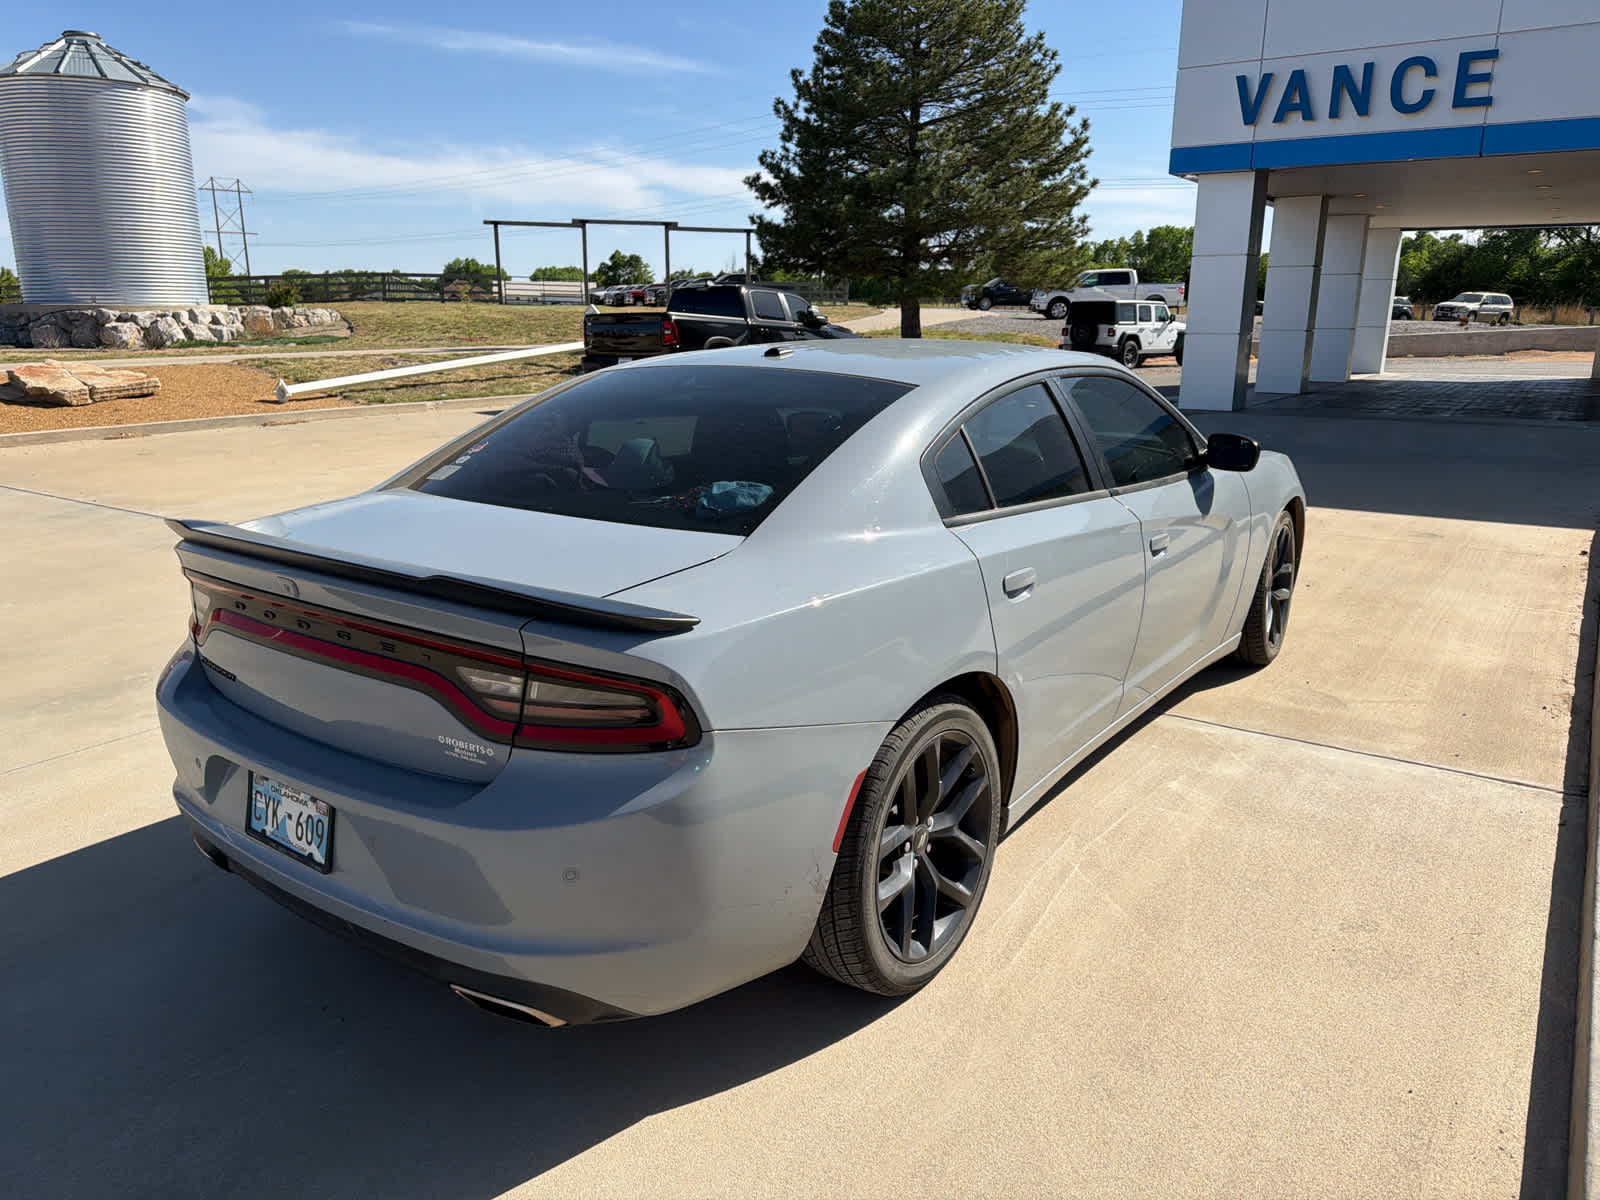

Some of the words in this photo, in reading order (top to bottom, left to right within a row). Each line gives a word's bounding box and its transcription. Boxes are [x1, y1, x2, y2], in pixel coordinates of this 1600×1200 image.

[1236, 48, 1500, 126] VANCE
[446, 736, 486, 755] ROBERTS
[270, 785, 309, 808] OKLAHOMA
